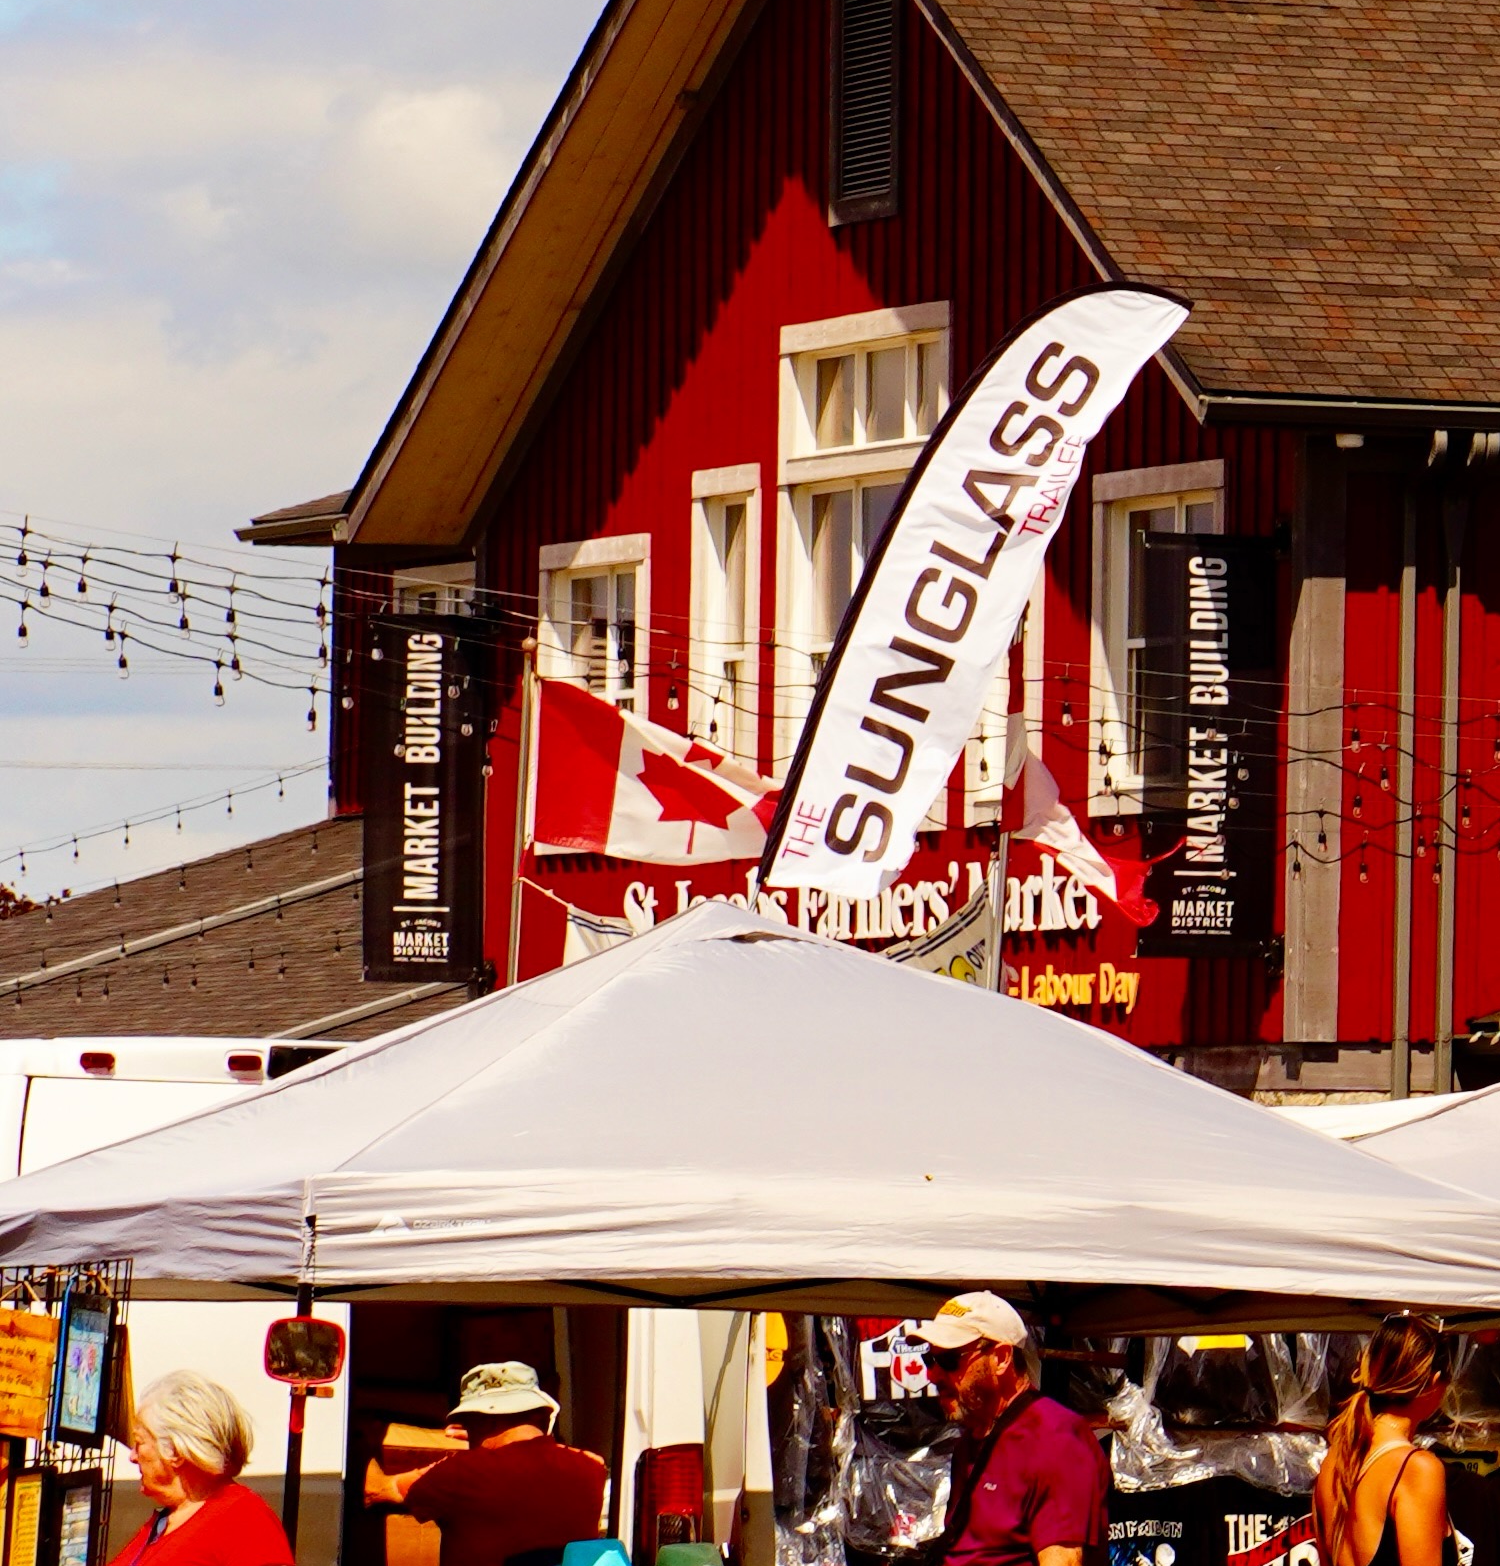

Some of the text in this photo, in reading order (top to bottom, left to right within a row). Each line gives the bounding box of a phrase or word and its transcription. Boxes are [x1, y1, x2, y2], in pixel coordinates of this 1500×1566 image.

[824, 341, 1100, 863] SUNGLASS
[1186, 556, 1229, 863] MARKET BUILDING
[403, 633, 443, 899] MARKET BUILDING
[781, 798, 827, 860] THE
[1171, 917, 1233, 927] DISTRICT
[1172, 900, 1234, 917] MARKET
[393, 932, 449, 946] MARKET
[393, 946, 449, 956] DISTRICT
[1021, 964, 1096, 1006] Labour
[1099, 962, 1140, 1014] Day
